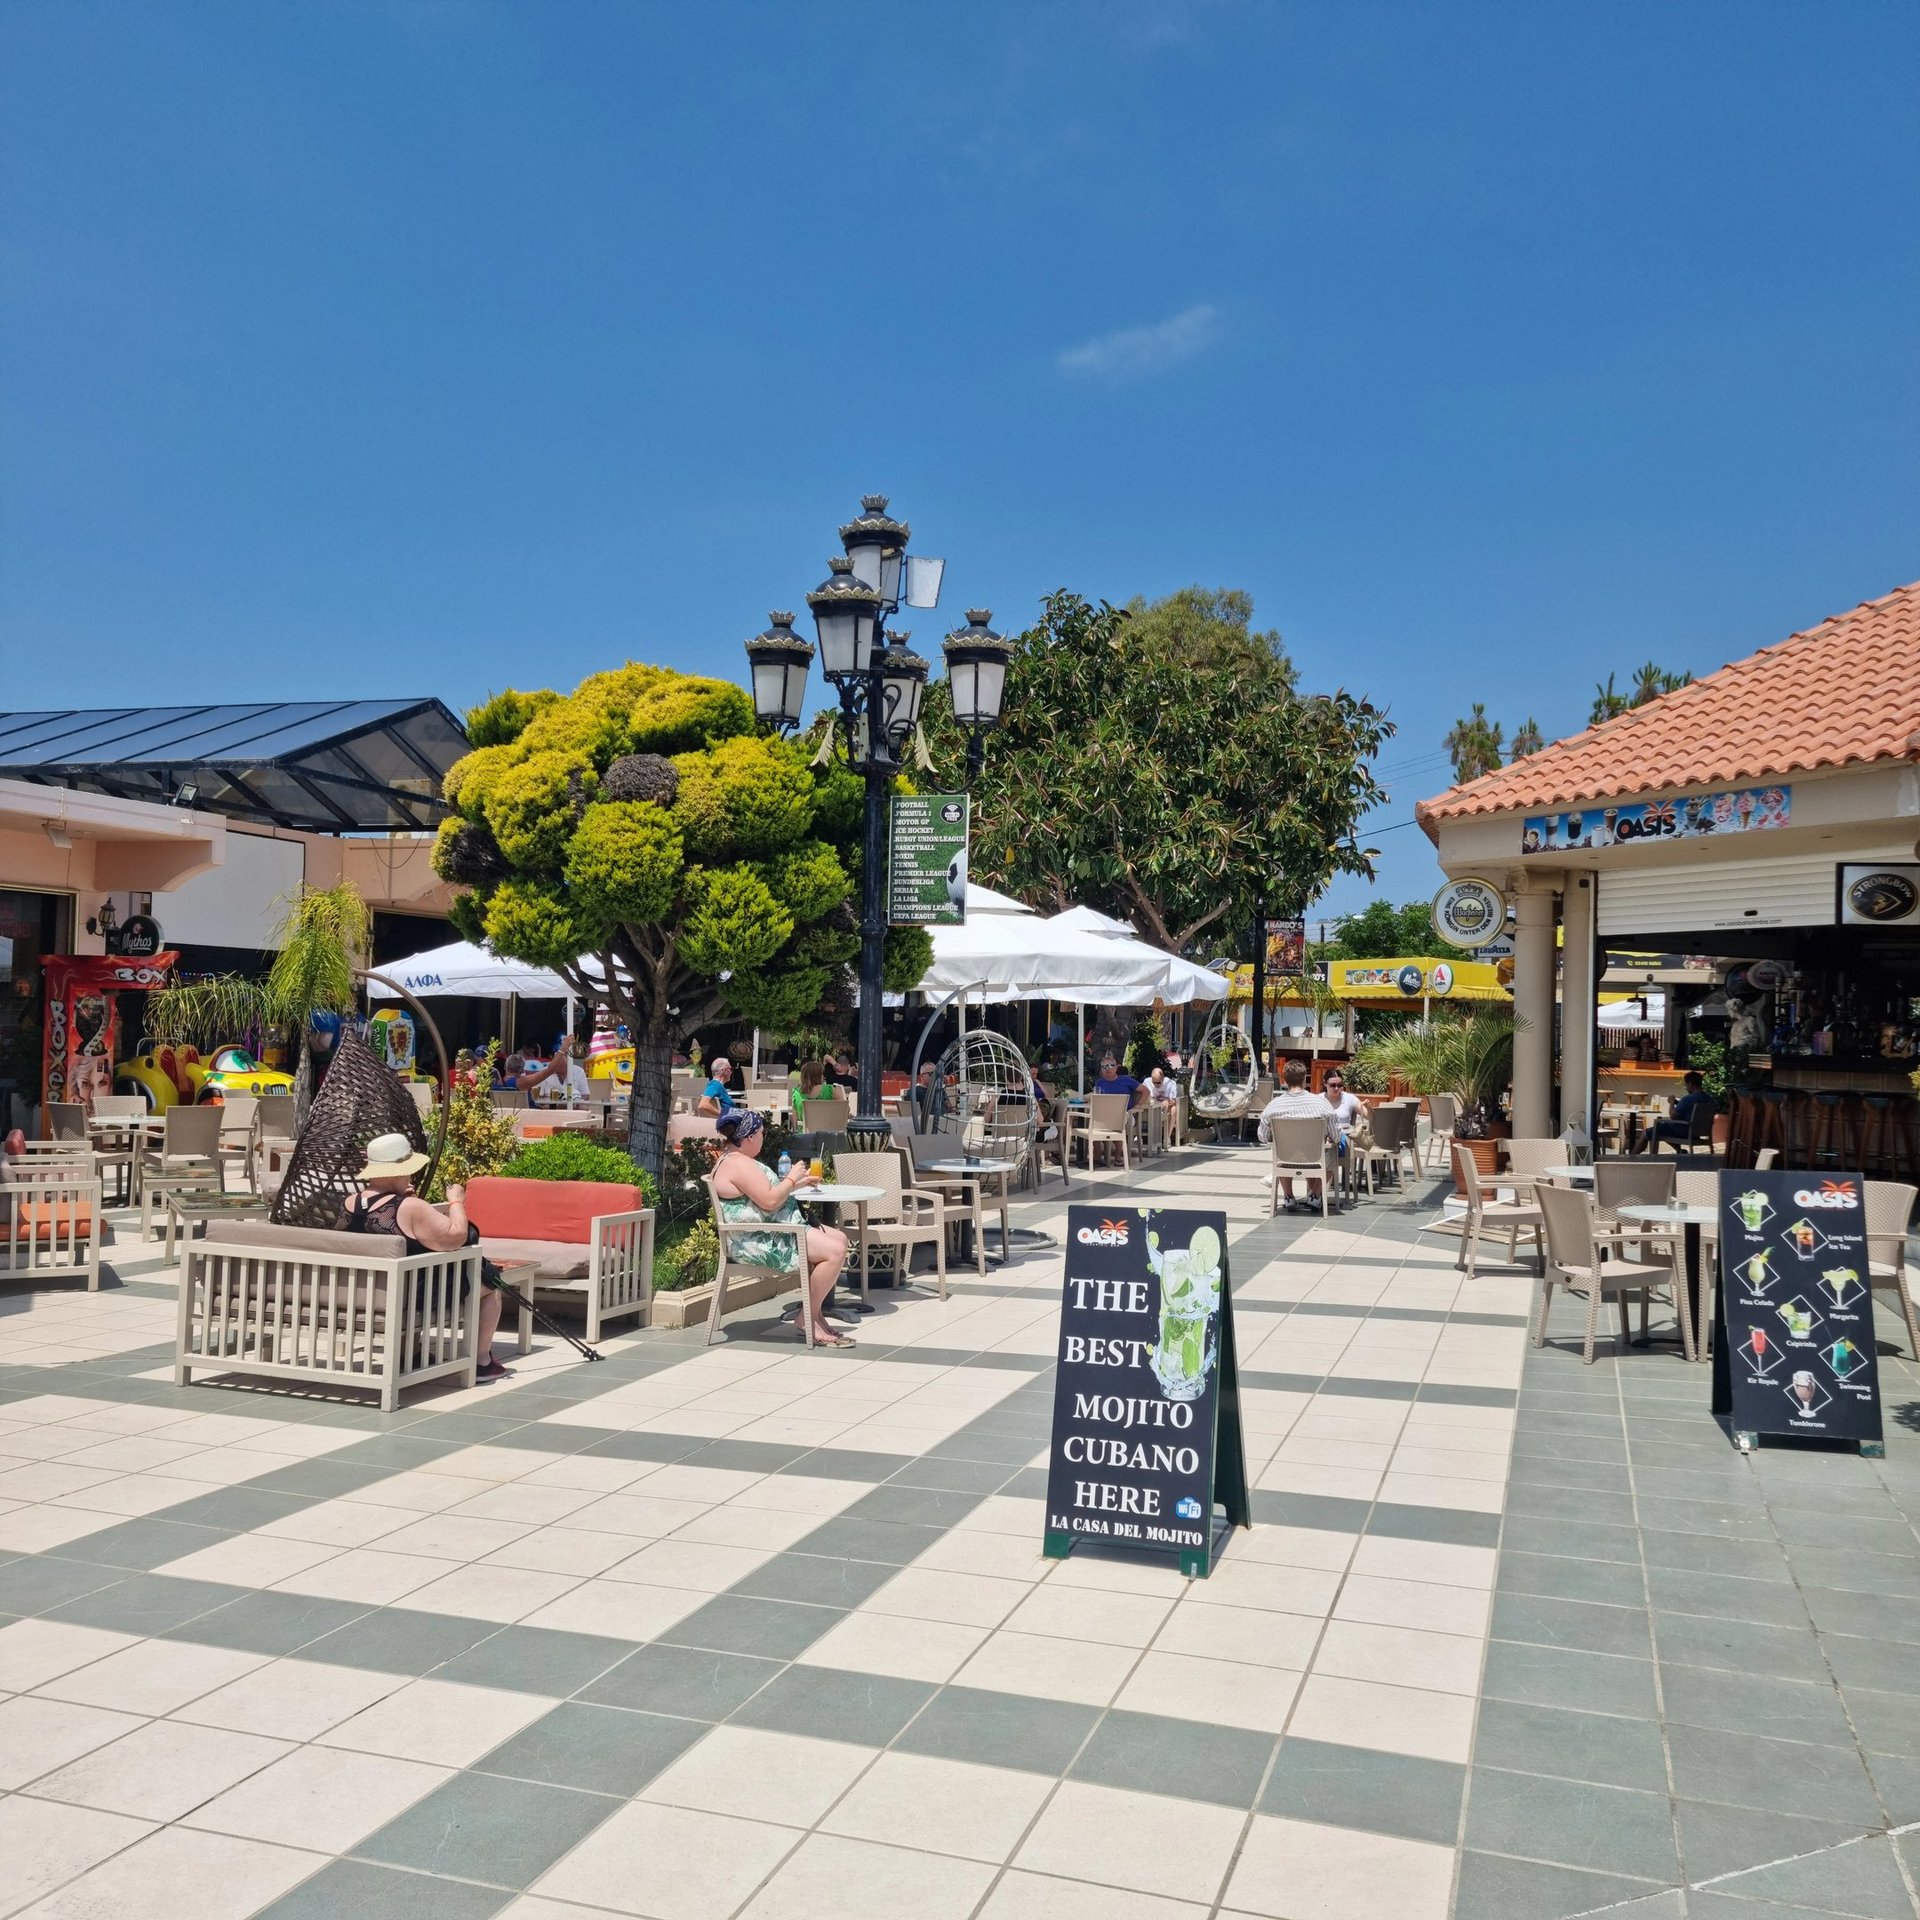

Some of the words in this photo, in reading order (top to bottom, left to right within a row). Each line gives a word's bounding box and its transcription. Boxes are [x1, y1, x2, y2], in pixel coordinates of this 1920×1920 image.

[1615, 814, 1677, 841] OASIS
[1853, 875, 1913, 898] STRONGBOW
[1444, 896, 1456, 909] EINE
[1482, 896, 1494, 918] BIEREN
[1459, 927, 1482, 935] UNTER
[1480, 918, 1492, 931] DEN
[121, 932, 153, 951] Mythos
[114, 967, 168, 984] BOX
[404, 973, 443, 989] ΑΛΦΑ
[1793, 1189, 1859, 1209] OASIS
[1077, 1227, 1129, 1245] OASIS
[1827, 1234, 1844, 1242] Long
[1843, 1234, 1863, 1242] Island
[1069, 1277, 1149, 1314] THE
[1829, 1312, 1860, 1321] Margarita
[1064, 1335, 1148, 1368] BEST
[1785, 1340, 1817, 1348] Caipirinha
[1758, 1377, 1779, 1386] Royale
[1838, 1382, 1871, 1392] Swimming
[1856, 1393, 1872, 1401] Pool
[1072, 1392, 1194, 1430] MOJITO
[1063, 1436, 1200, 1475] CUBANO
[1073, 1480, 1161, 1517] HERE
[1051, 1514, 1069, 1530] LA
[1072, 1517, 1110, 1535] CASA
[1113, 1521, 1142, 1539] DEL
[1146, 1526, 1203, 1546] MOJITO
